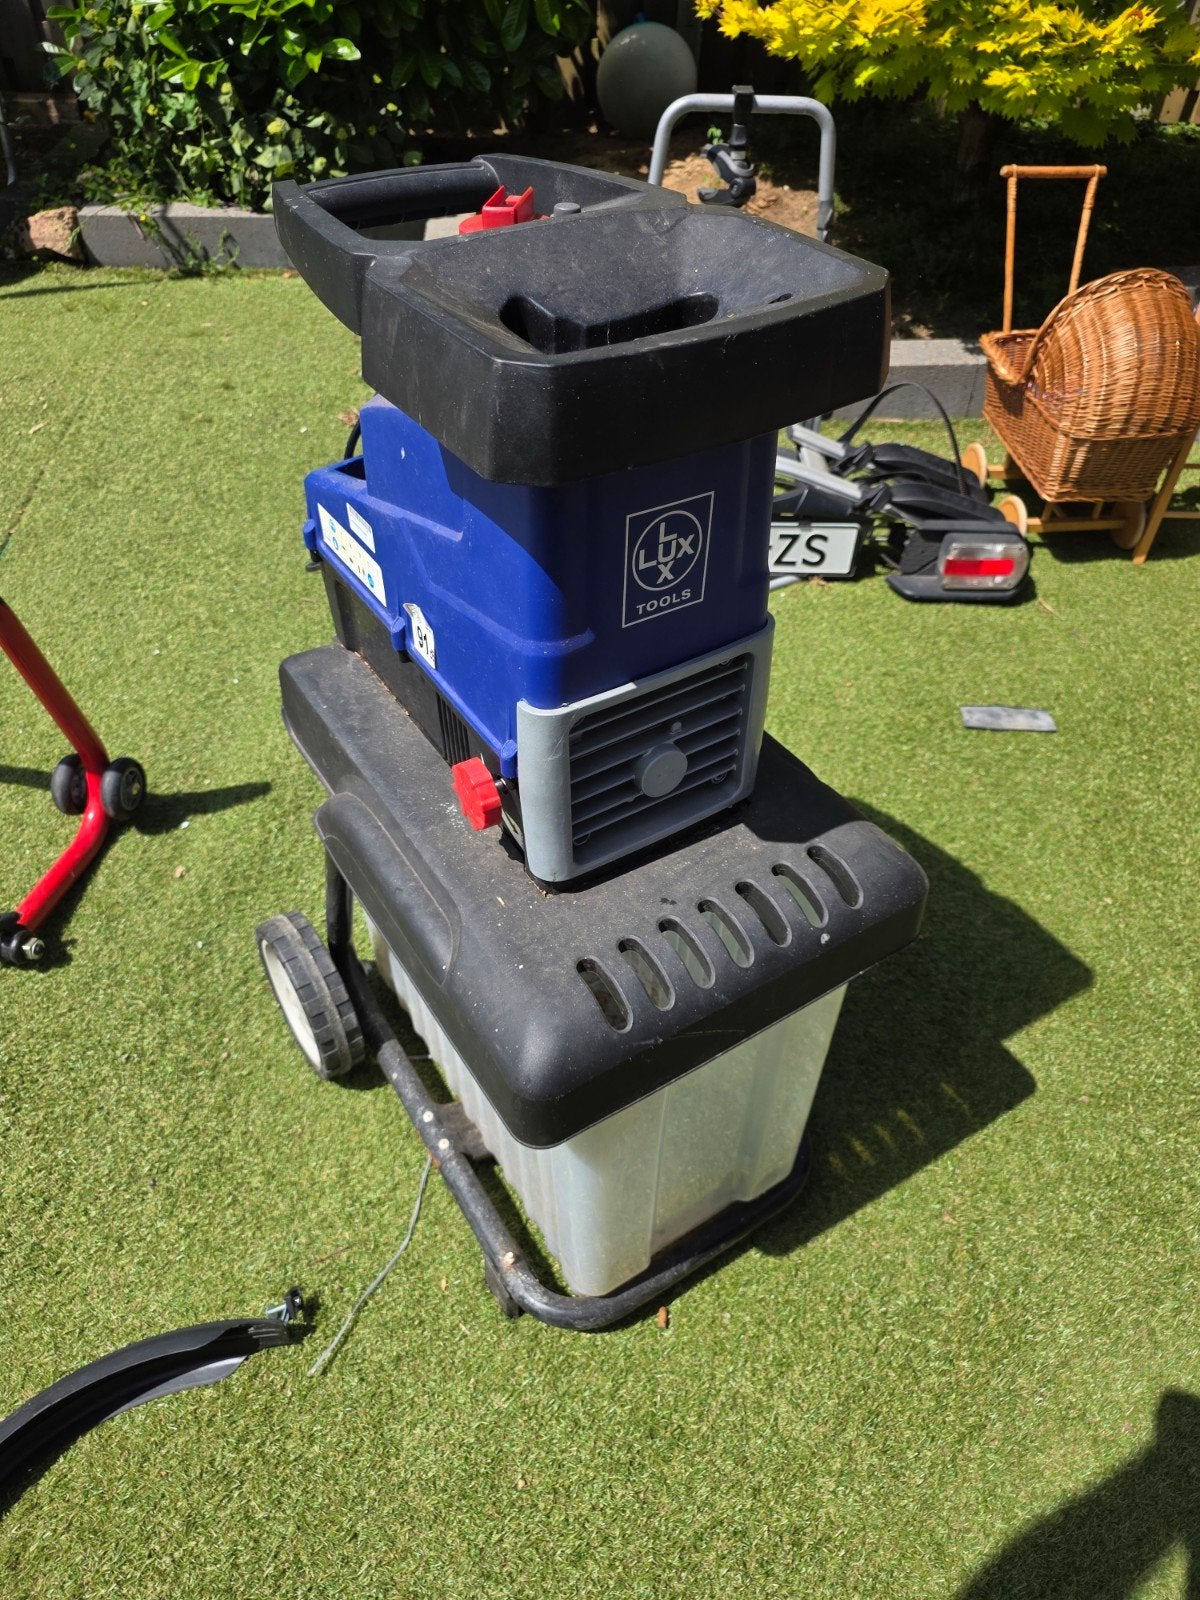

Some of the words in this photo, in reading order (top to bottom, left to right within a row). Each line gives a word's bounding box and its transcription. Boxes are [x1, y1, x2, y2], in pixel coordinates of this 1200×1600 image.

[638, 533, 695, 571] LUX
[656, 521, 678, 584] LUX
[636, 588, 691, 615] TOOLS
[416, 625, 429, 655] 91
